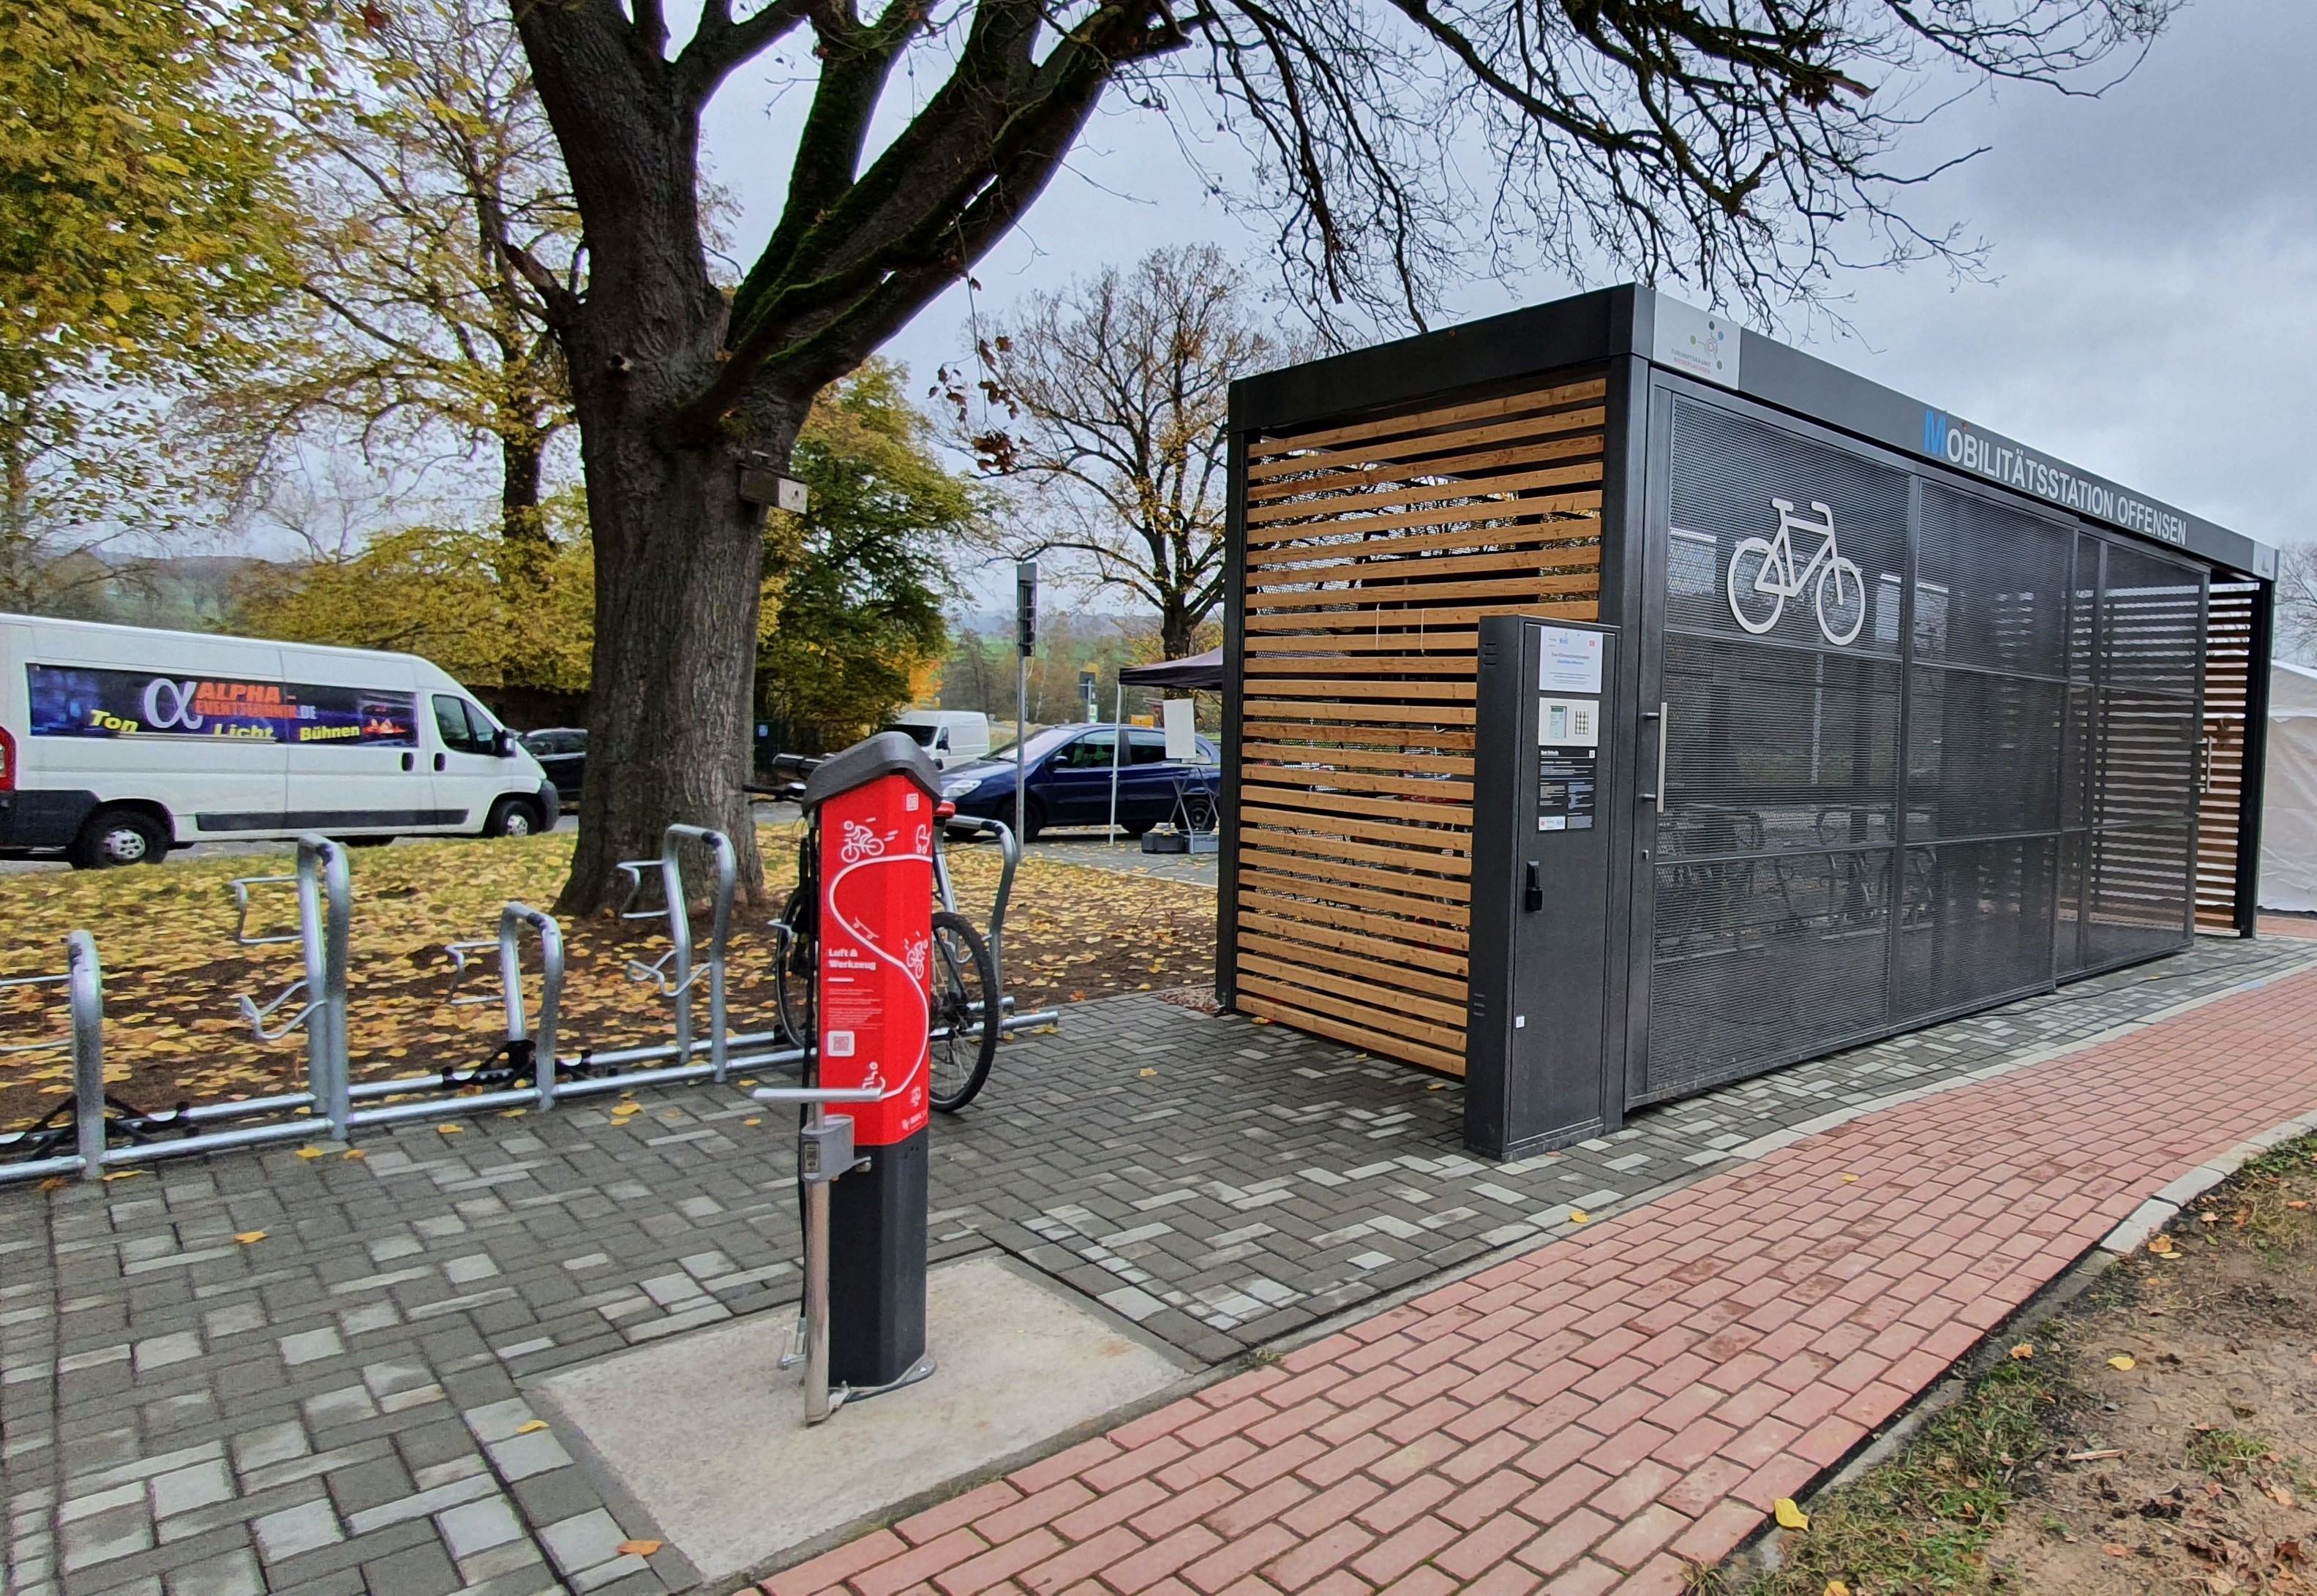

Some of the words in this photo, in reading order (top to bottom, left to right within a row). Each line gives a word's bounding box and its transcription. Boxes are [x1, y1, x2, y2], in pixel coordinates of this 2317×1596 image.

[1923, 410, 2114, 520] MOBILITÄTSSTATION
[2117, 496, 2188, 546] OFFENSEN
[89, 709, 139, 734] Ton
[214, 723, 274, 737] Licht
[299, 725, 361, 742] Bühnen
[828, 948, 849, 957] Luft
[828, 959, 876, 971] Werkzeug
